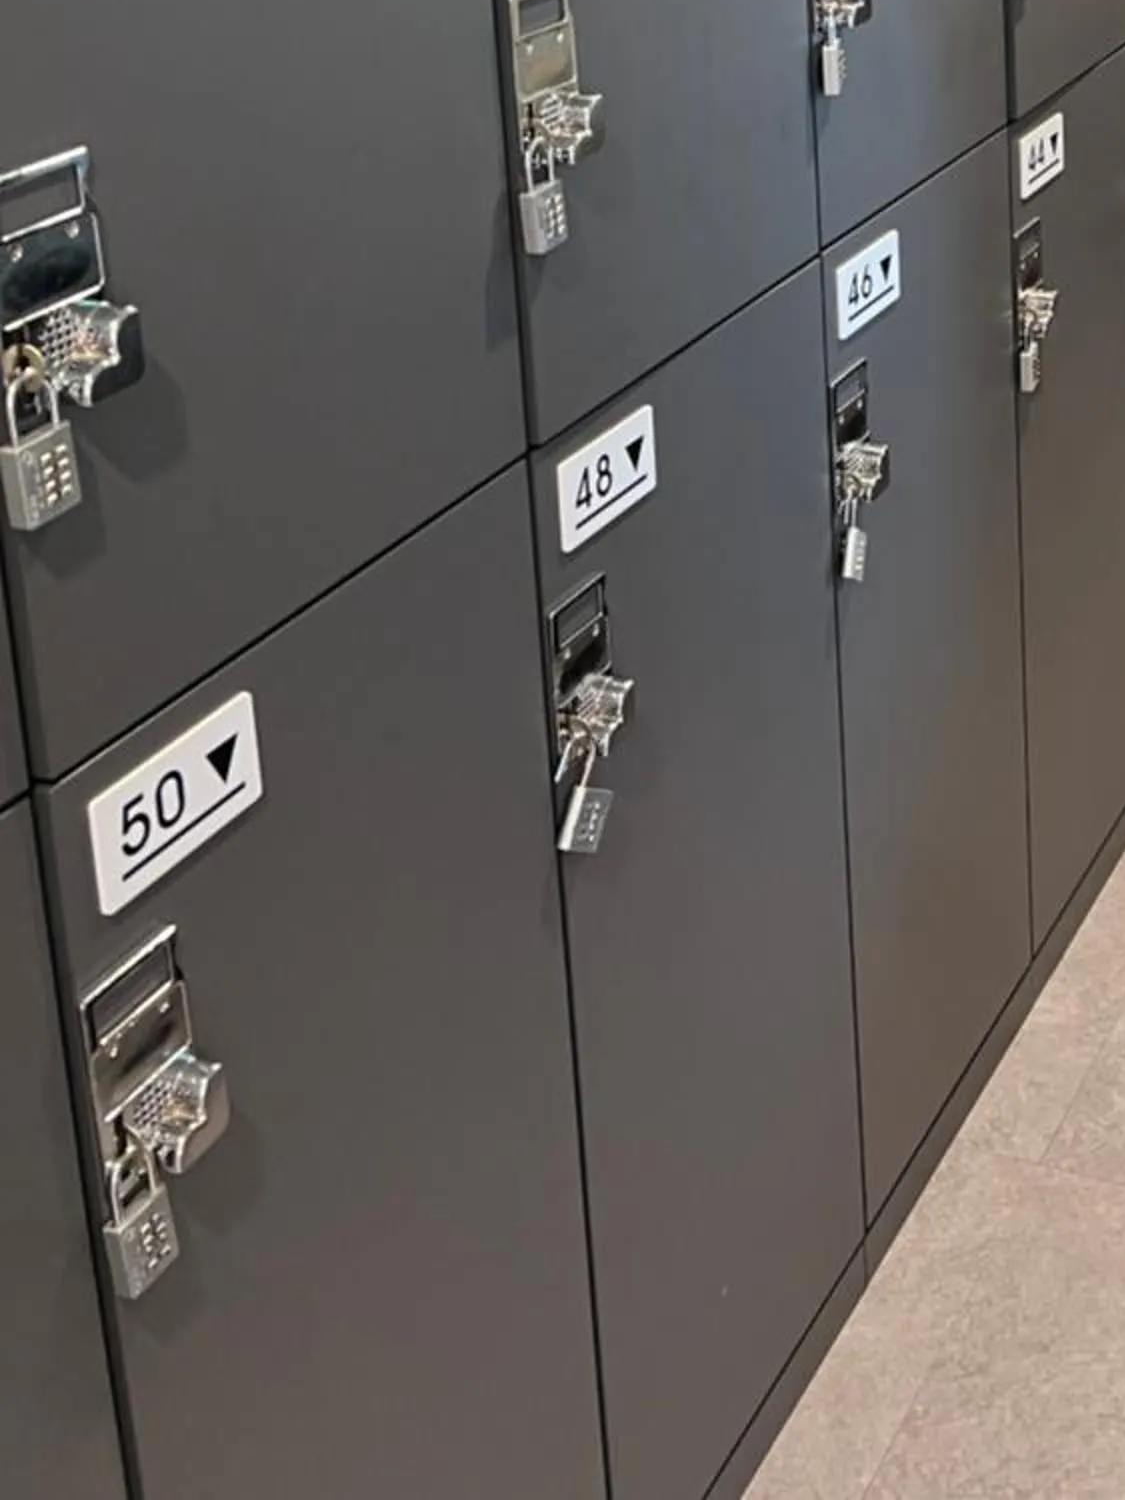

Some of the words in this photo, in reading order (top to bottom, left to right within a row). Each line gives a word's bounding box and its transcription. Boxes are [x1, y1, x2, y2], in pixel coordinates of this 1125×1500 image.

[1028, 138, 1045, 170] 44
[848, 263, 873, 305] 46
[575, 453, 613, 508] 48
[121, 769, 185, 857] 50
